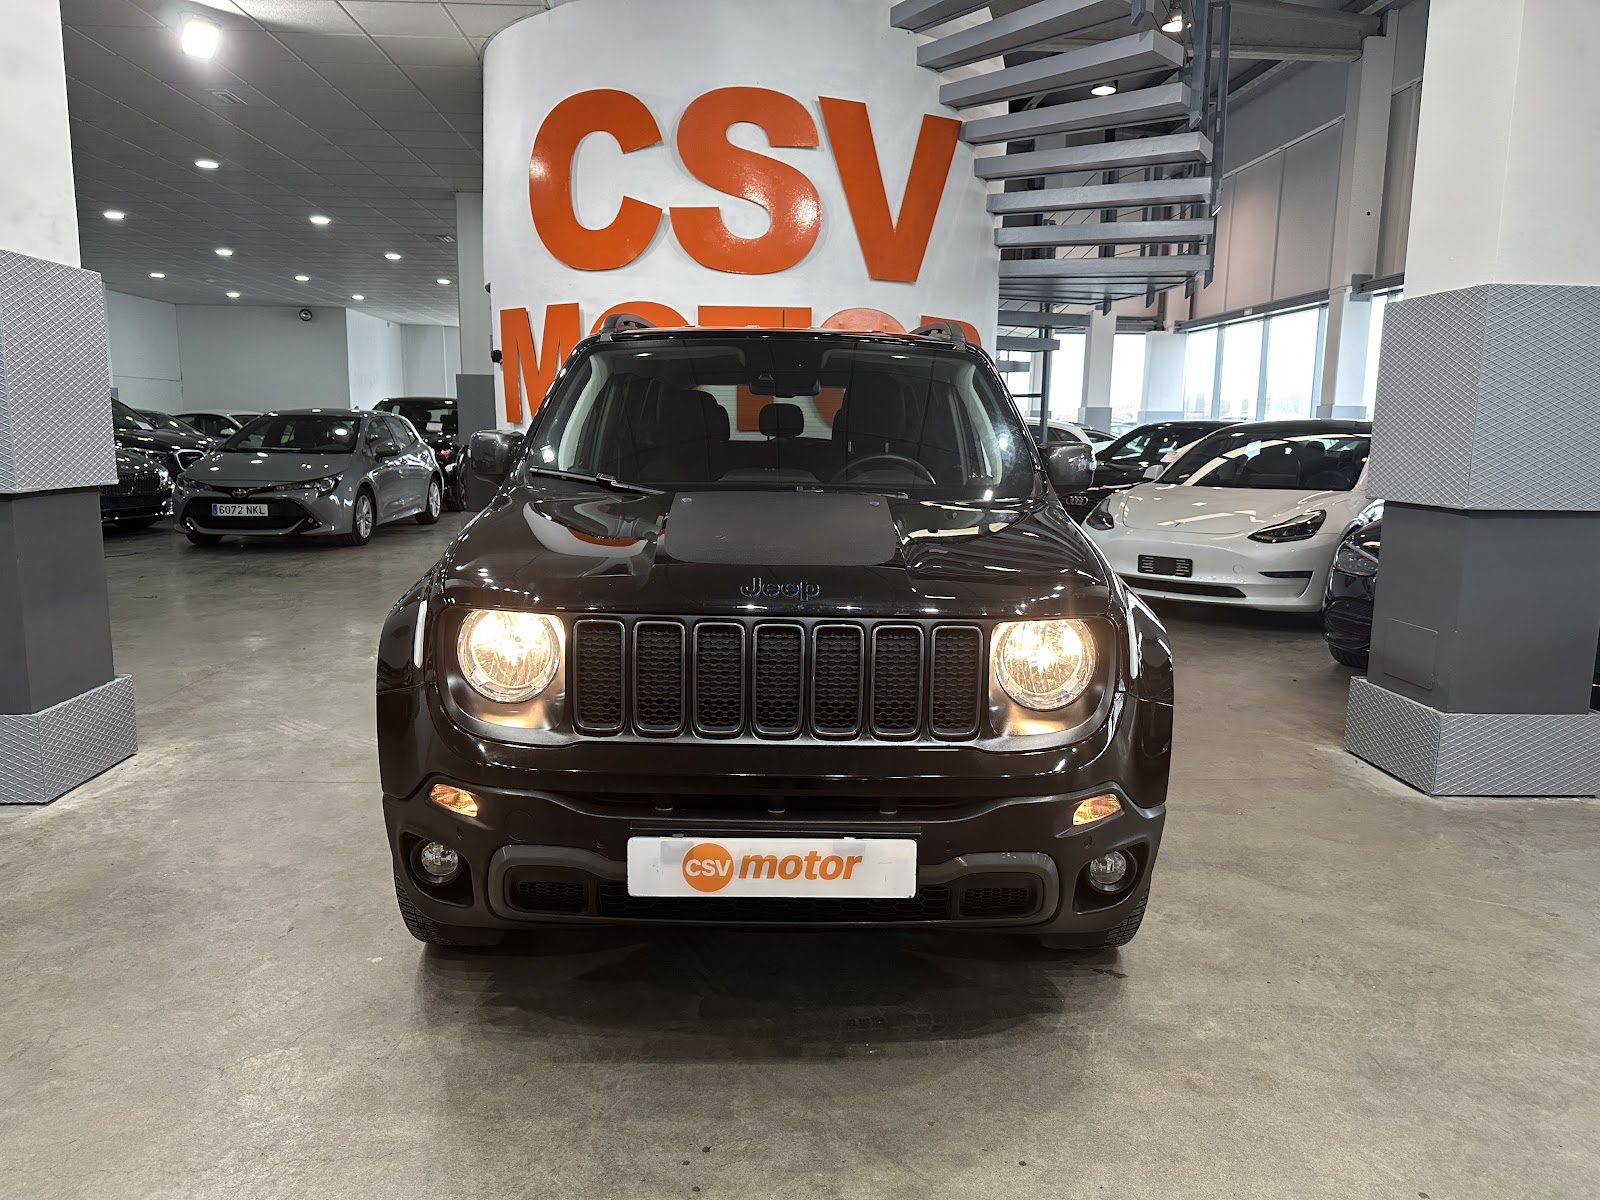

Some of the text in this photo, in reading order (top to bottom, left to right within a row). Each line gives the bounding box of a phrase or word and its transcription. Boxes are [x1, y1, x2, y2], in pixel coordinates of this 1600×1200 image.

[528, 86, 963, 283] CSV
[219, 505, 243, 515] 6072
[246, 505, 266, 515] NKL
[740, 577, 820, 602] Jeep
[738, 850, 863, 881] motor
